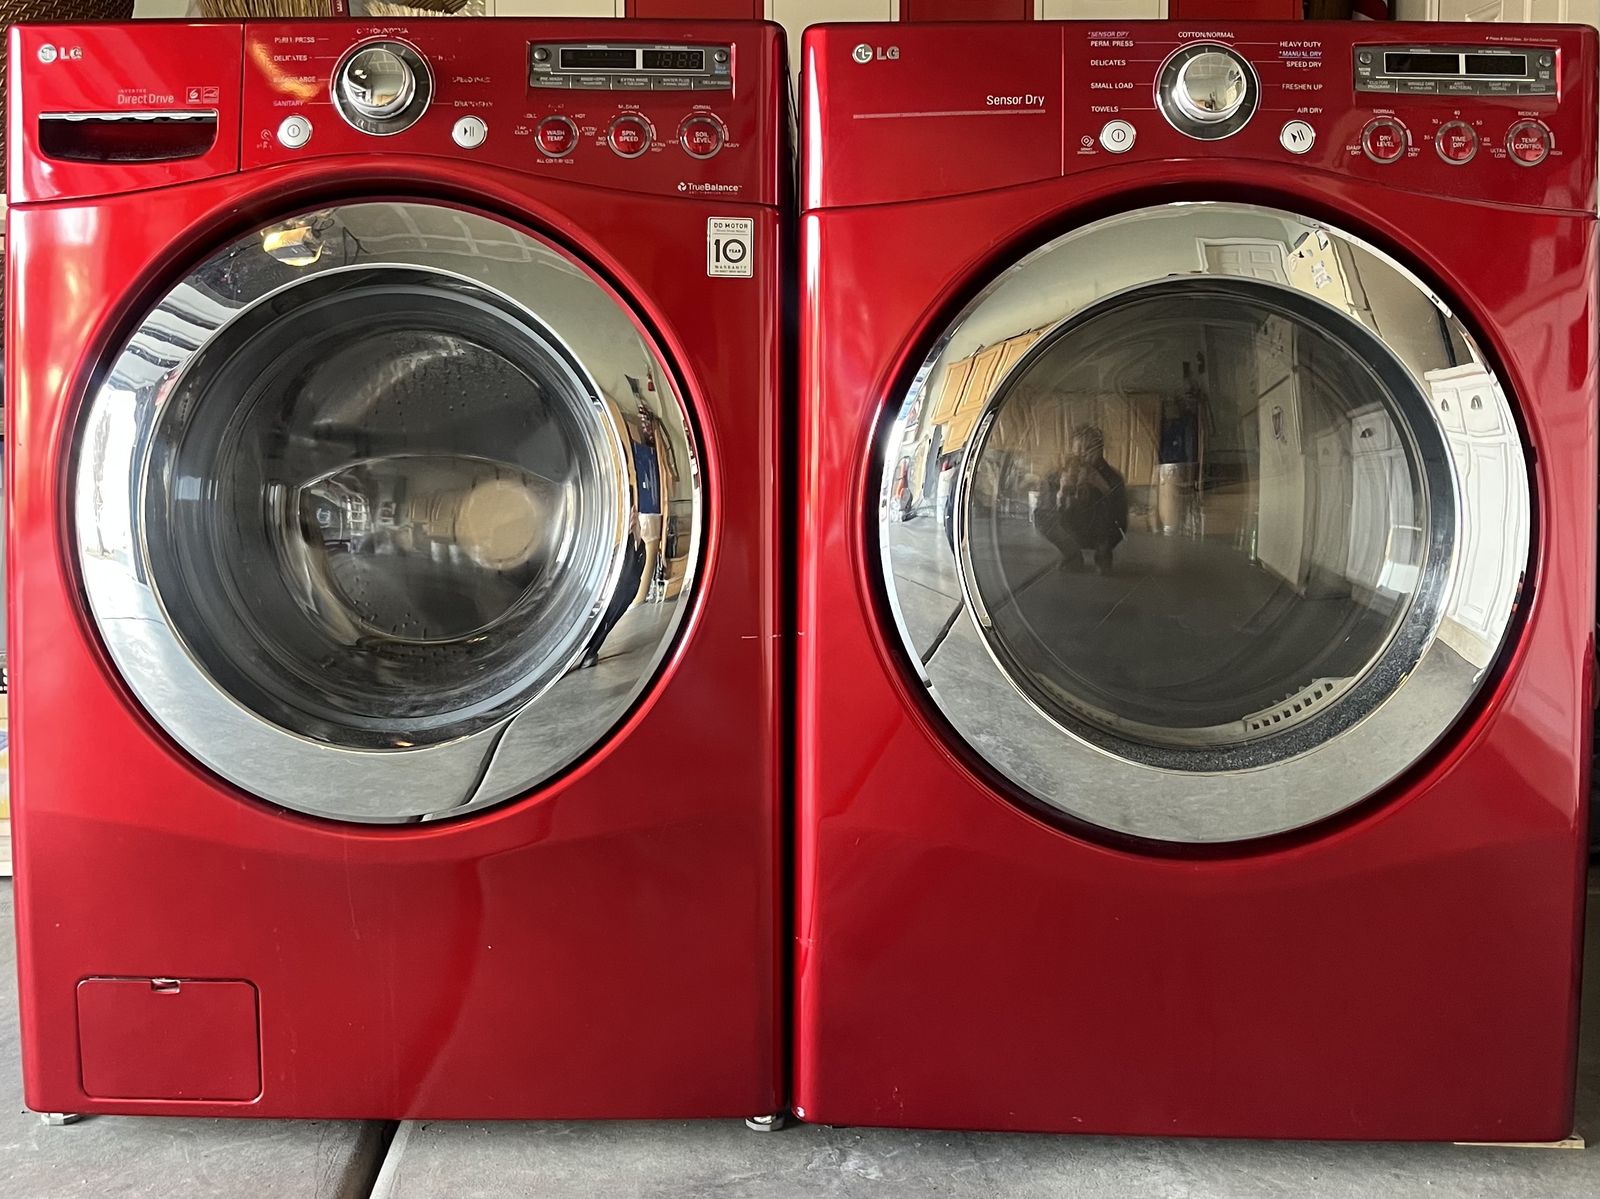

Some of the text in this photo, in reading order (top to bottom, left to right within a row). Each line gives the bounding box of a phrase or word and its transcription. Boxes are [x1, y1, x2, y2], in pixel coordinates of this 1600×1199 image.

[60, 46, 82, 60] LG
[877, 46, 900, 60] LG
[118, 94, 147, 105] Direct
[149, 93, 174, 104] Drive
[986, 94, 1045, 106] Sensor Dry
[714, 239, 747, 264] 10
